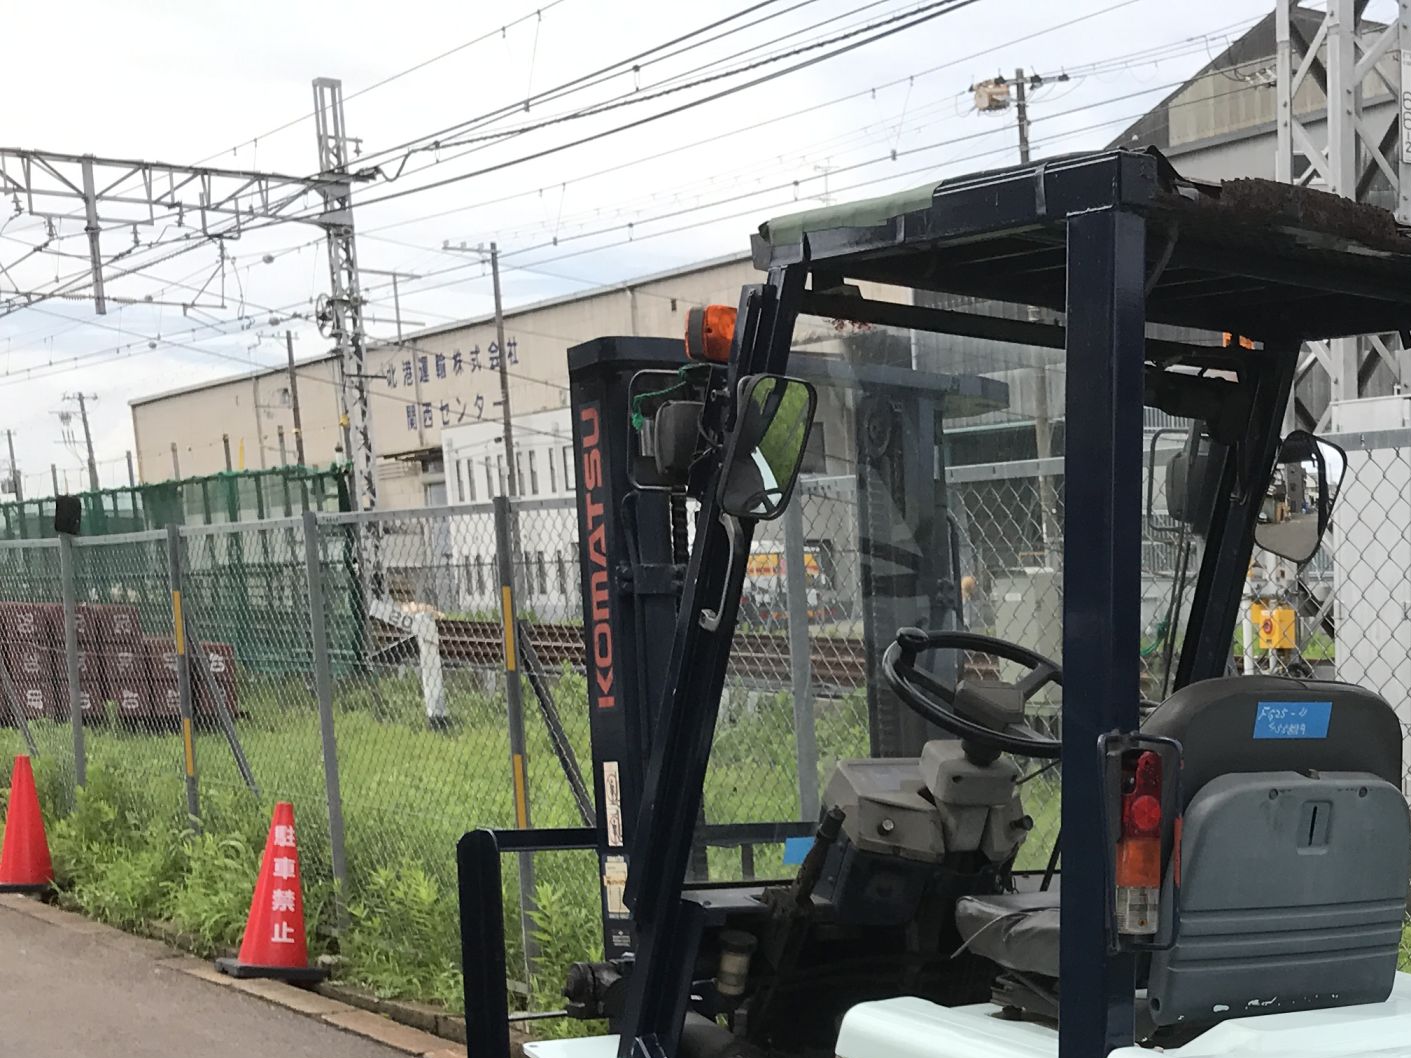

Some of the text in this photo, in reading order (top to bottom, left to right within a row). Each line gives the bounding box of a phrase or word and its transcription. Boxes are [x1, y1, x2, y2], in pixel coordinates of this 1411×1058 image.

[580, 406, 615, 708] KOMATSU
[271, 824, 296, 944] 駐車禁止
